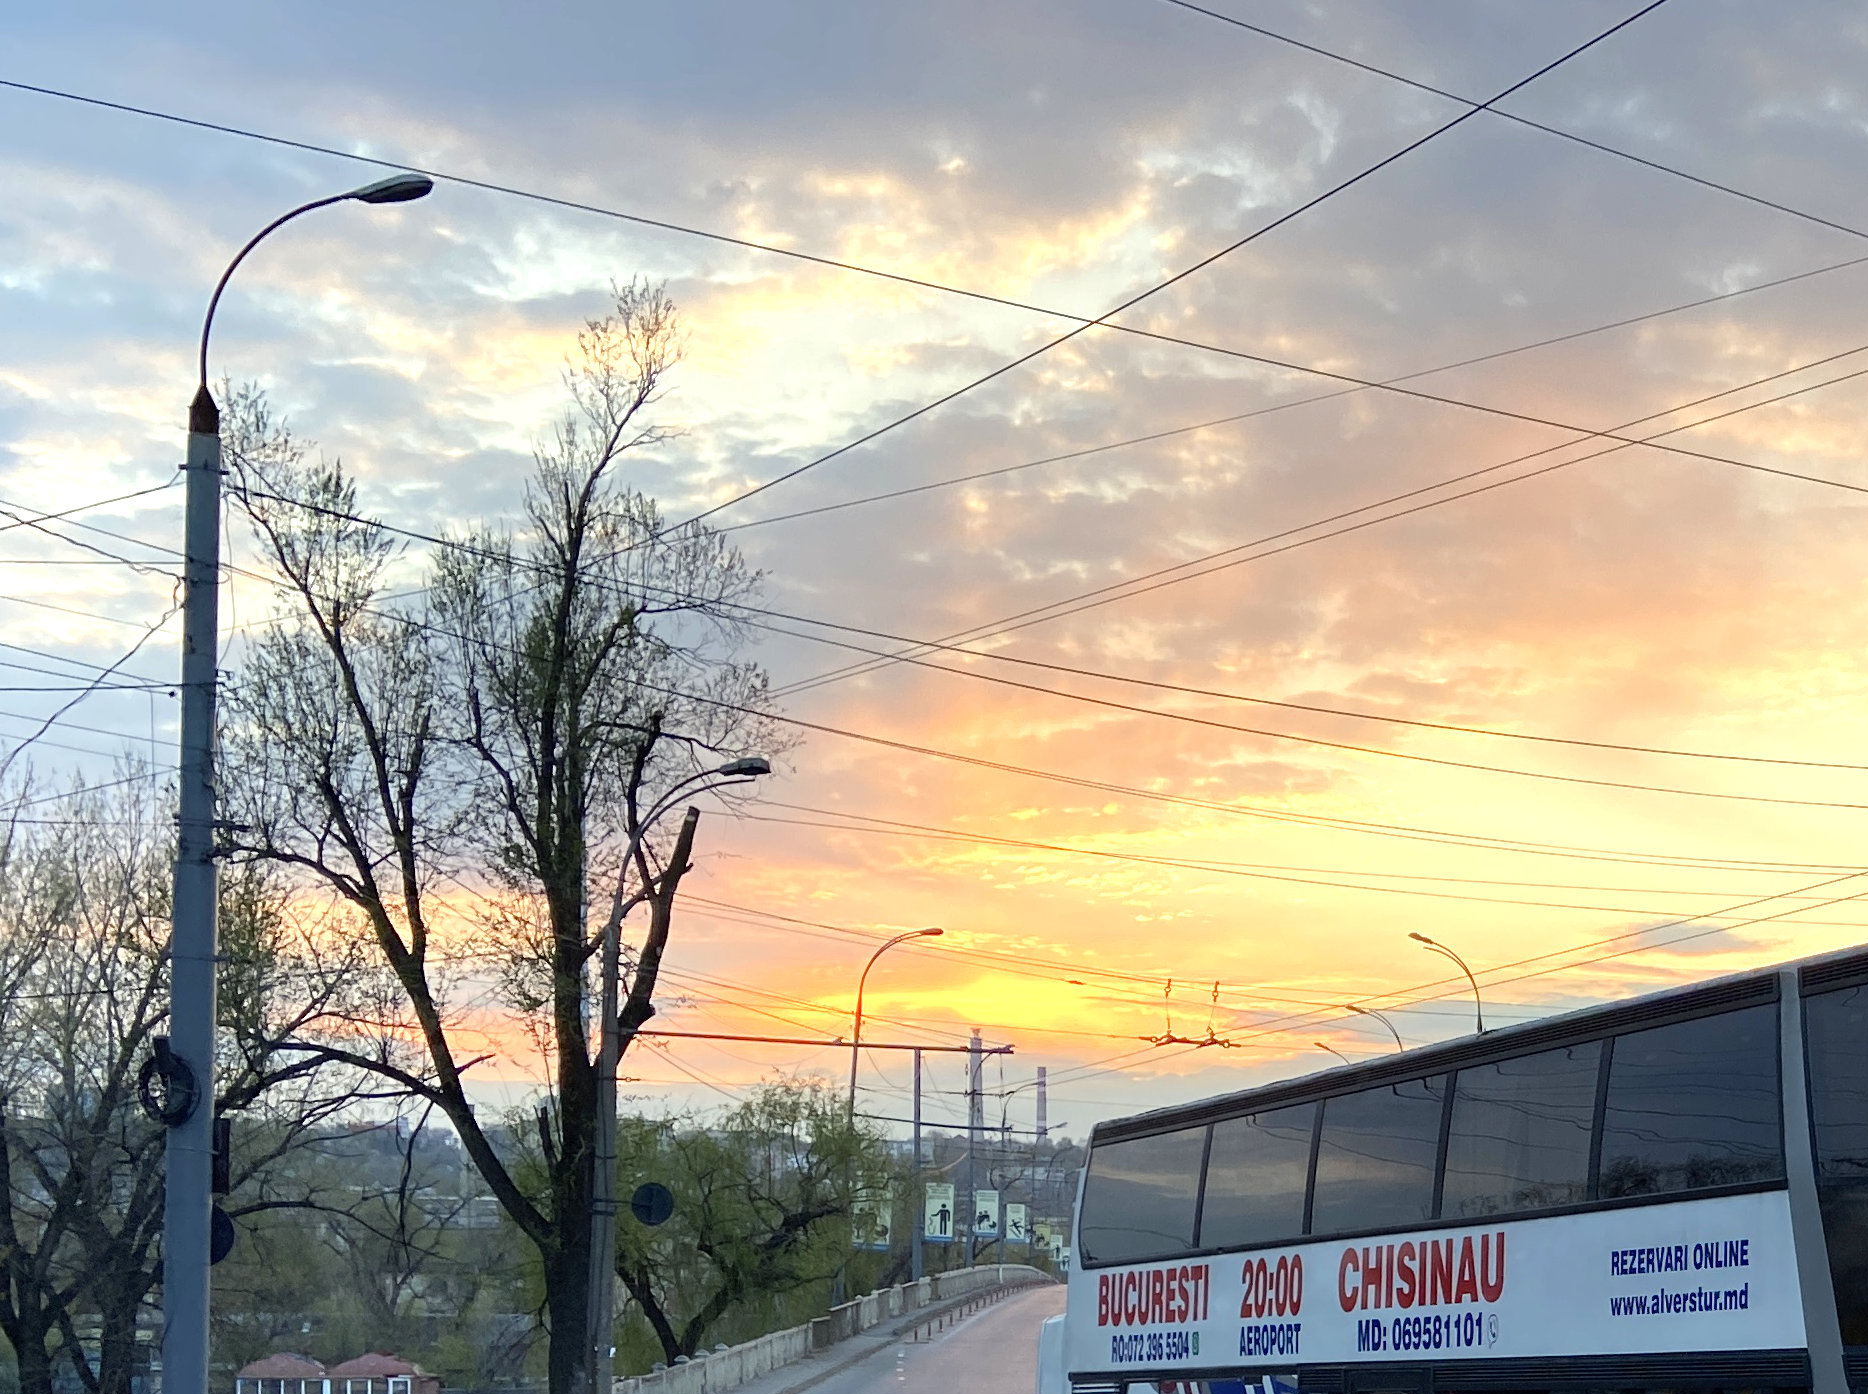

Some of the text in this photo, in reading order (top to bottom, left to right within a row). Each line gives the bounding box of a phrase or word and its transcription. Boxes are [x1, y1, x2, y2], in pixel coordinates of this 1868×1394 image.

[1338, 1231, 1505, 1313] CHISINAU
[1611, 1239, 1749, 1276] REZERVARI ONLINE
[1098, 1264, 1209, 1327] BUCURESTI
[1240, 1254, 1303, 1318] 20:00
[1610, 1282, 1749, 1316] www.alverstur.md
[1111, 1331, 1189, 1363] RO:072 396 5504
[1239, 1324, 1301, 1356] AEROPORT
[1357, 1312, 1483, 1352] MD: 069581101
